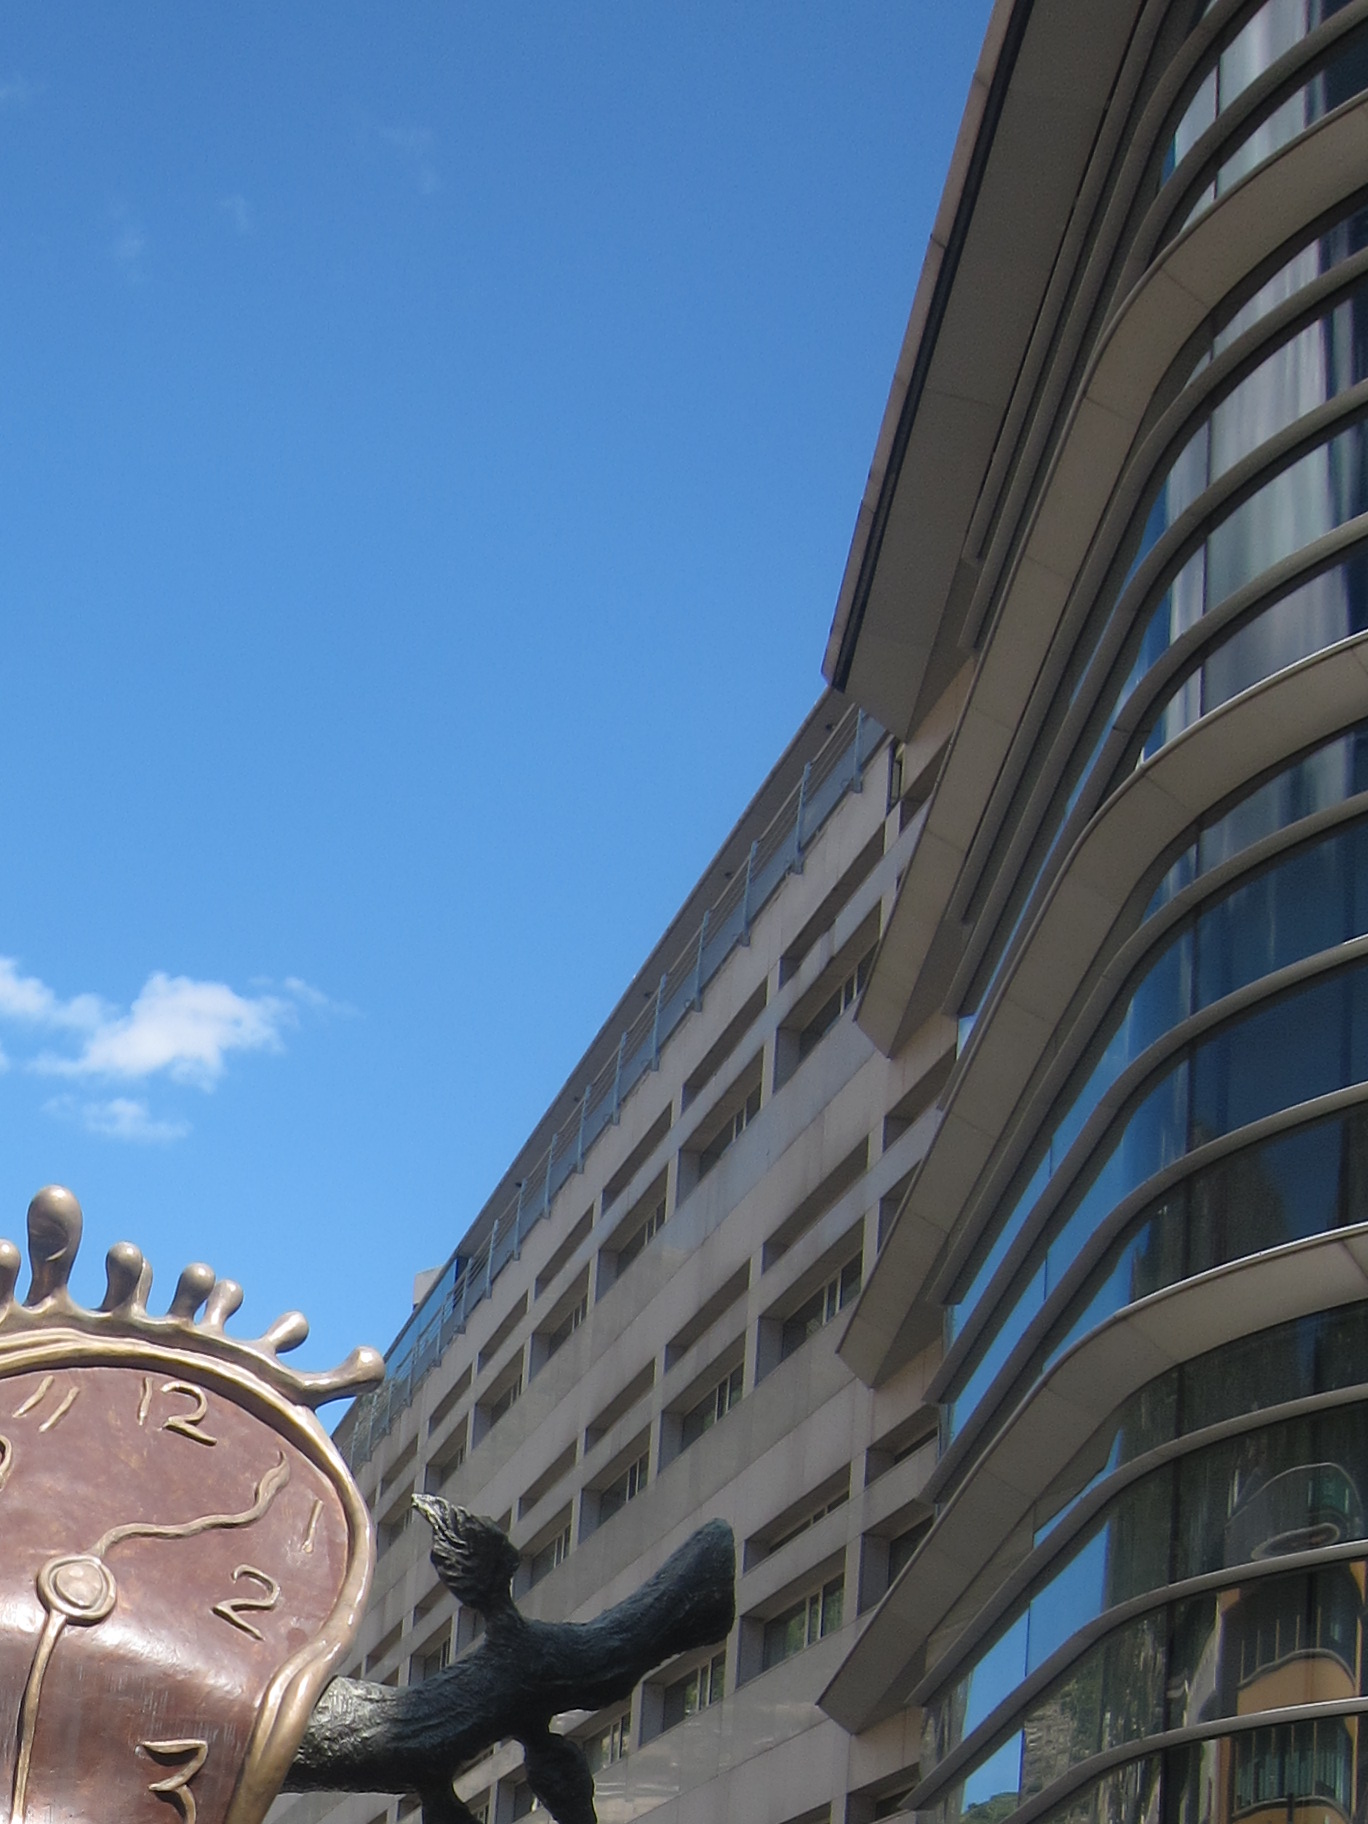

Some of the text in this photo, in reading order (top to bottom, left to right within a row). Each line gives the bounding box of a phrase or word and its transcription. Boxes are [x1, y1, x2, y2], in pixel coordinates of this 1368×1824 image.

[12, 1375, 80, 1432] 11
[137, 1376, 218, 1446] 12
[301, 1499, 326, 1554] 1
[212, 1563, 282, 1642] 2
